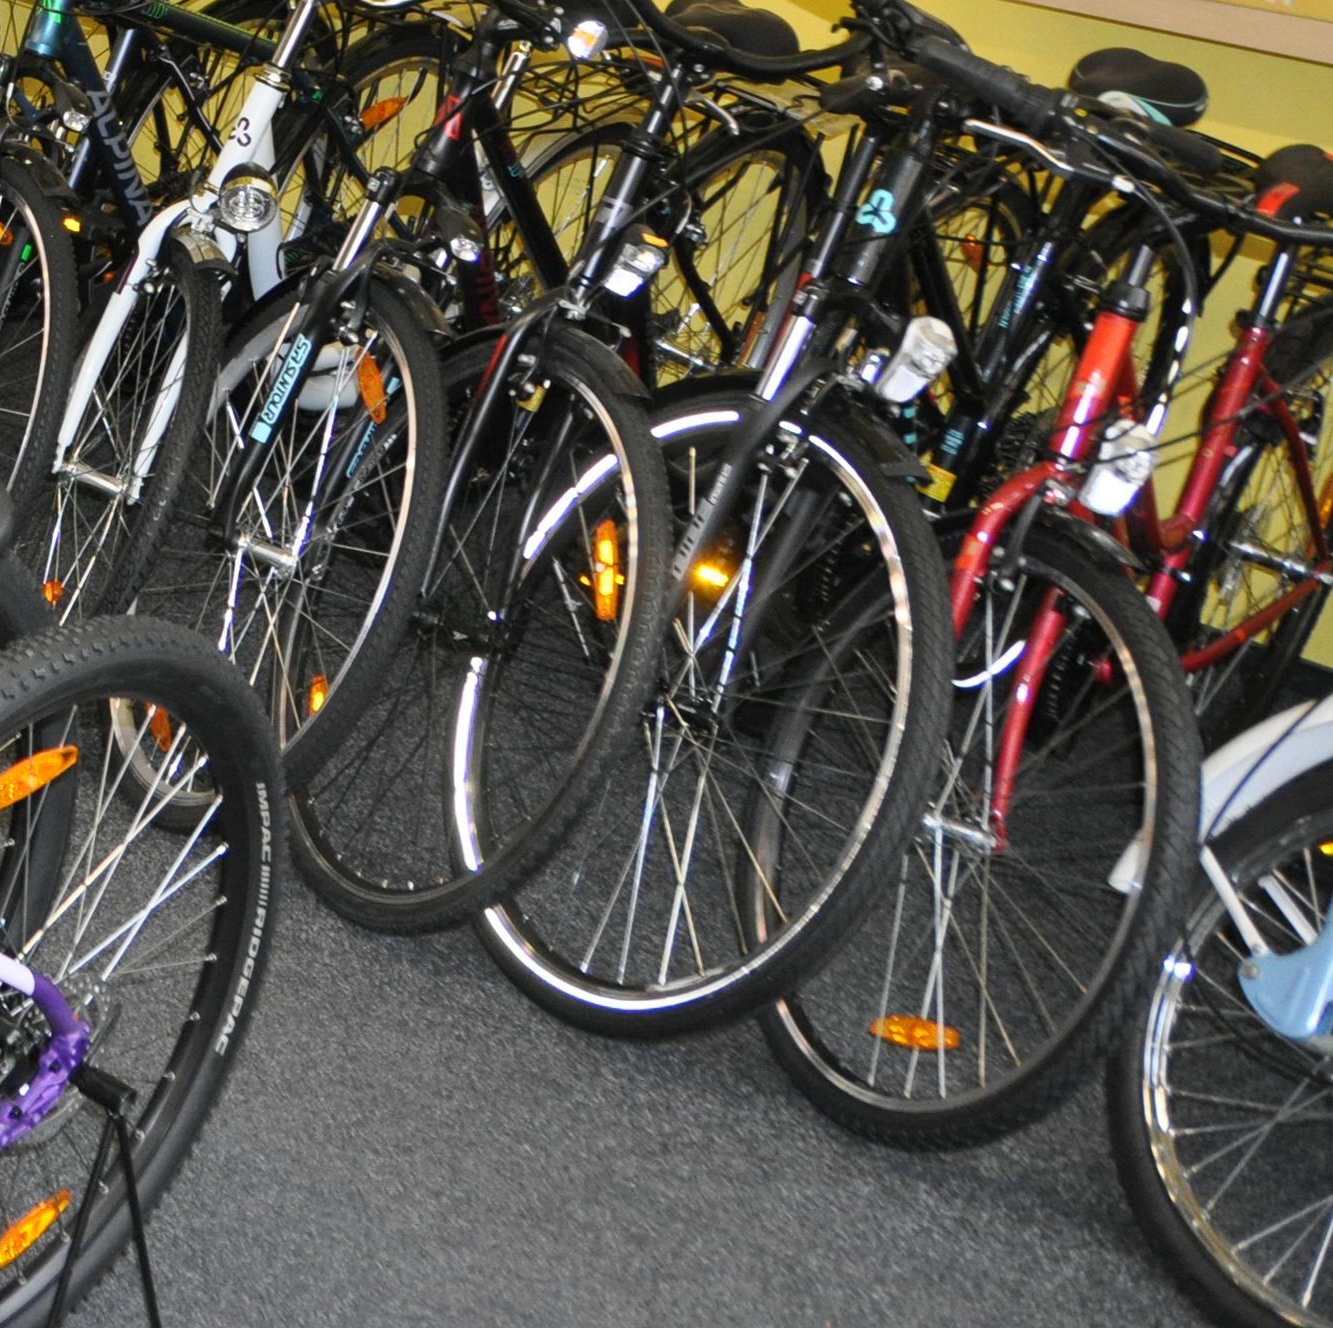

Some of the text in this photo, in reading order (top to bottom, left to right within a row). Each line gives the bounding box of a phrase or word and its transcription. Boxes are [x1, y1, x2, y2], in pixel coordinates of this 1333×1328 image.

[86, 89, 154, 228] ALPINA
[263, 336, 312, 424] SR SUNTOUR
[255, 781, 272, 863] IMPAC
